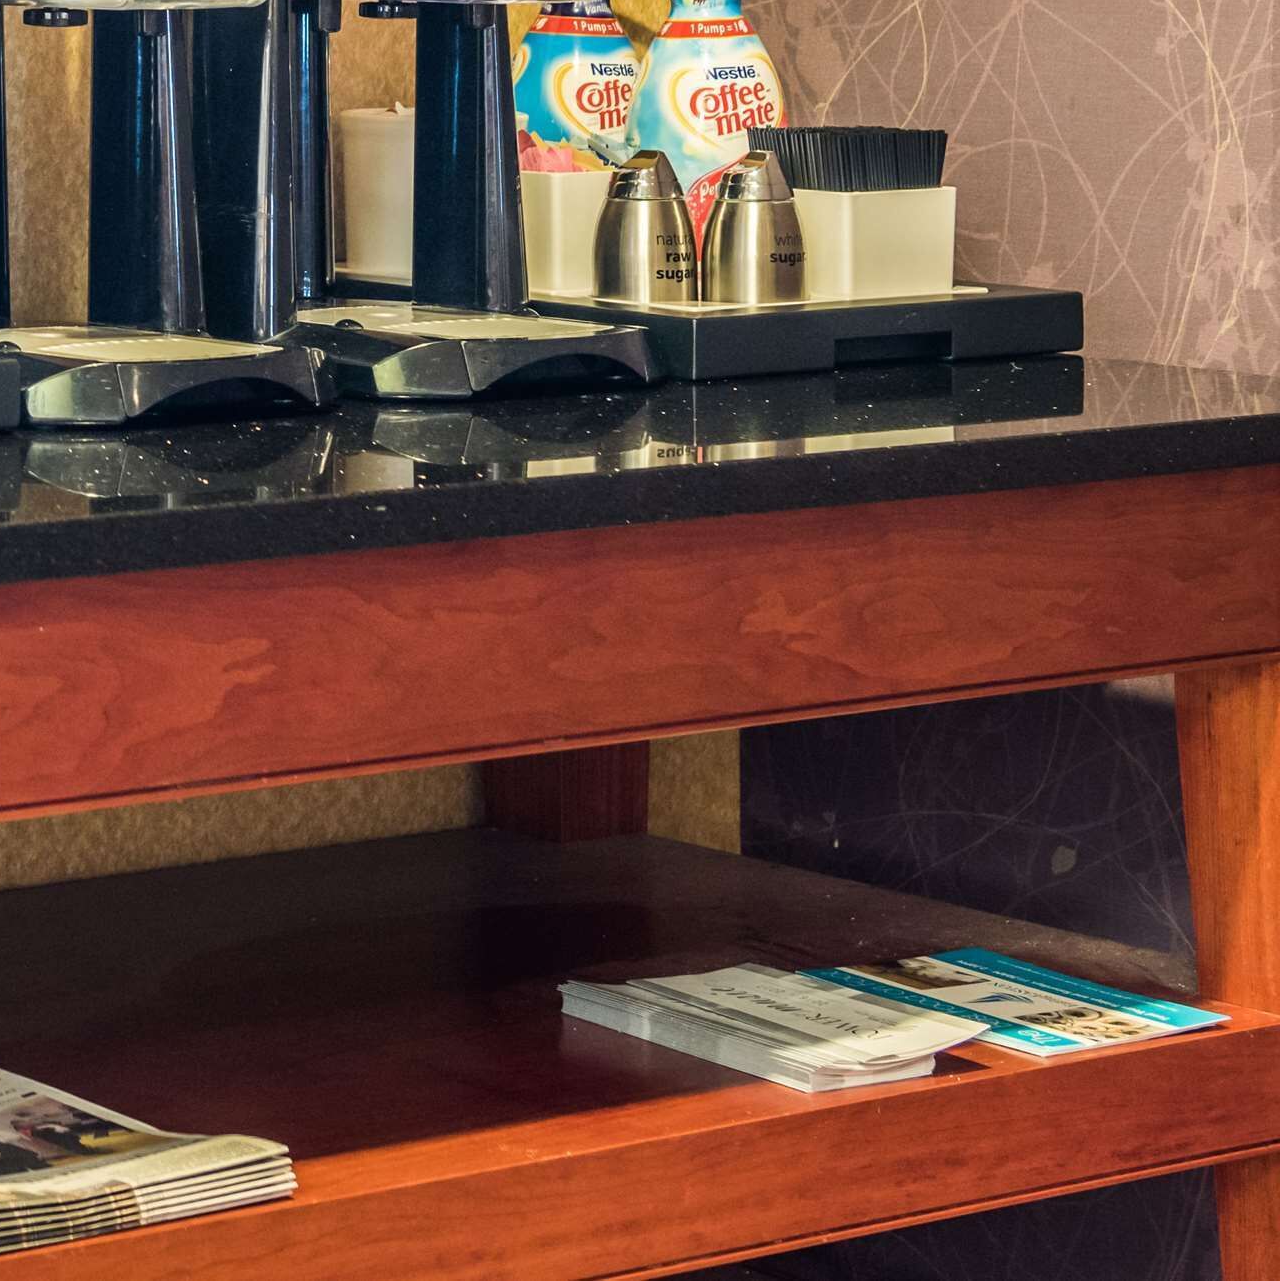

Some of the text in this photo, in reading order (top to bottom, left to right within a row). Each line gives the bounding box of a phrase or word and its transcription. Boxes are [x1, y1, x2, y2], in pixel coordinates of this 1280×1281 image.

[591, 63, 635, 77] Nestlé
[705, 65, 756, 79] Nestlé
[715, 101, 776, 136] mate
[666, 252, 692, 263] raw
